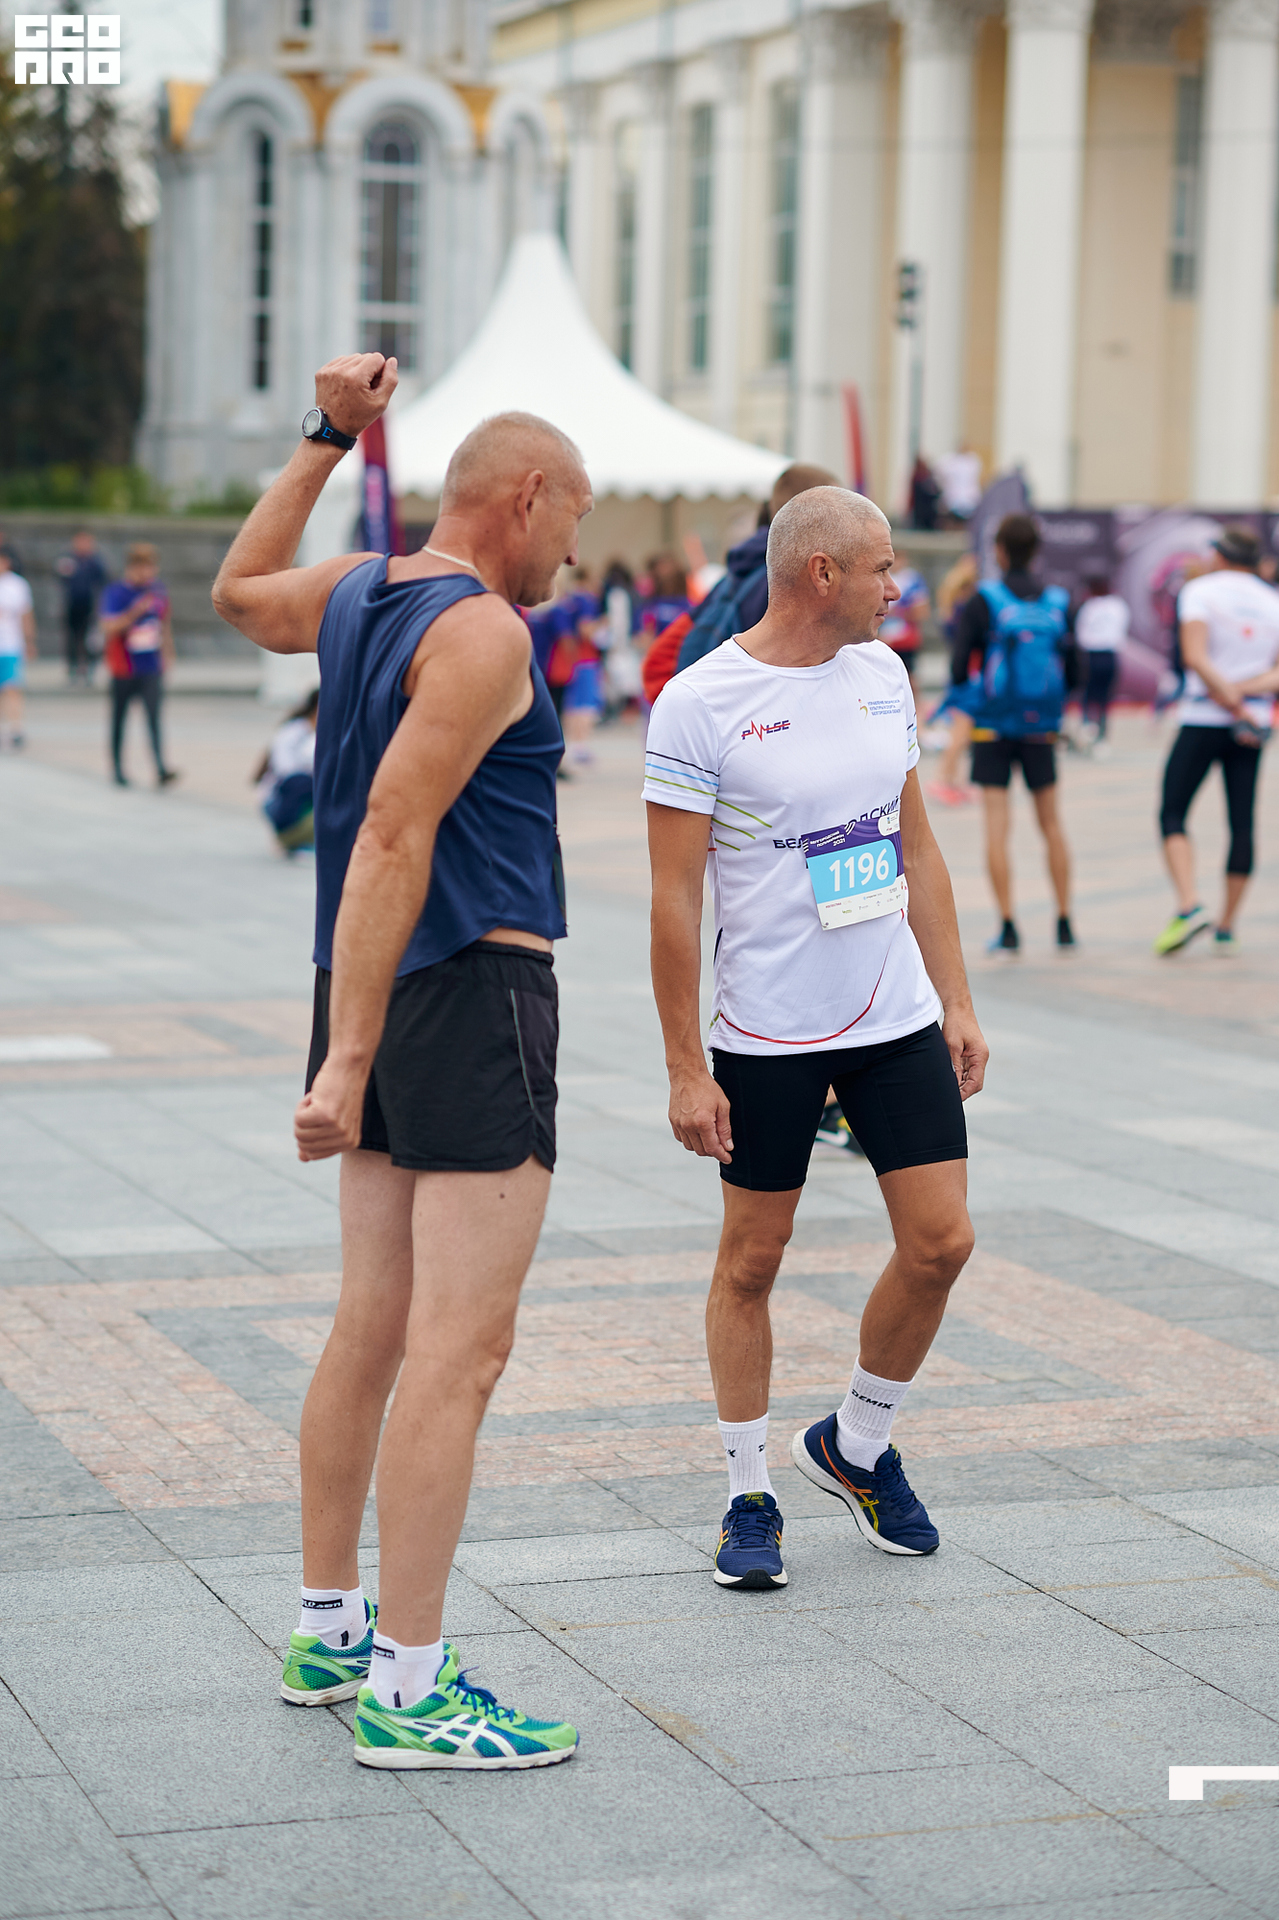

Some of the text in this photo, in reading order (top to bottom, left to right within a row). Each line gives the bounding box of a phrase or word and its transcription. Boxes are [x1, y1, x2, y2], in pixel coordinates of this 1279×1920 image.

[833, 838, 846, 847] 2021
[829, 848, 889, 892] 1196
[852, 1388, 894, 1410] DEMIX
